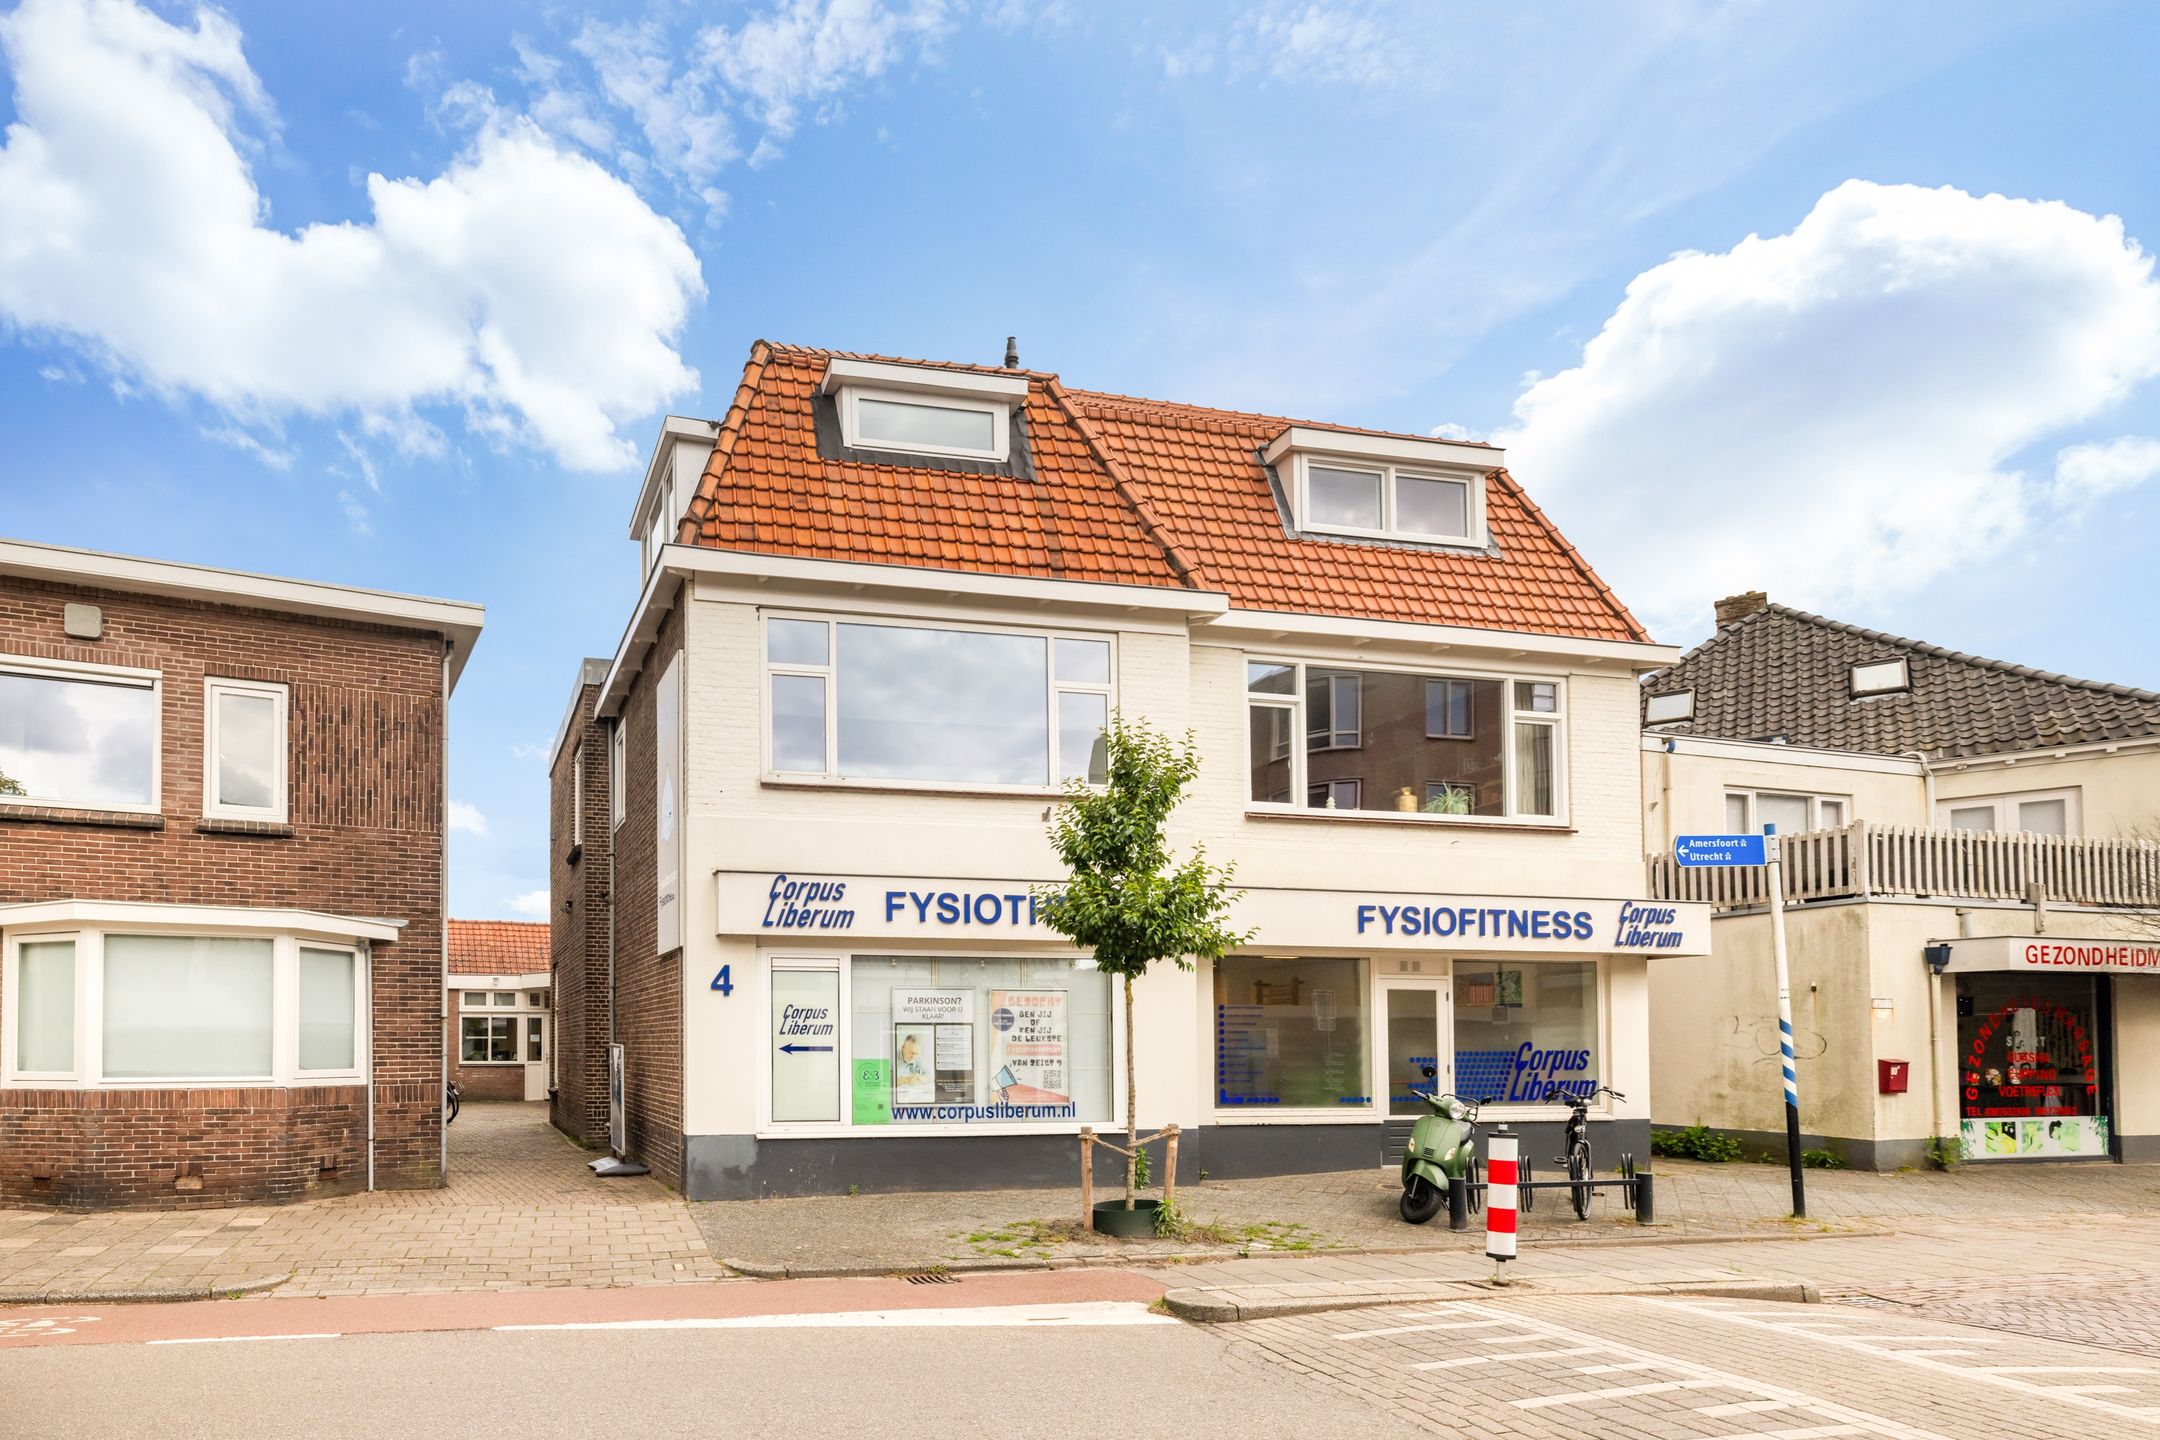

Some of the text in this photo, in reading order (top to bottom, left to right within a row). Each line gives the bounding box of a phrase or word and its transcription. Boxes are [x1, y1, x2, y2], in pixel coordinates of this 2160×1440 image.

[1689, 839, 1739, 848] Amersfoort
[1690, 852, 1723, 861] Utrecht
[769, 874, 846, 907] Corpus
[762, 902, 855, 928] Liberum
[885, 891, 1066, 926] FYSIOTH
[1619, 901, 1677, 929] Corpus
[1357, 905, 1594, 939] FYSIOFITNESS
[1615, 924, 1683, 947] Liberum
[710, 964, 734, 997] 4
[783, 1004, 828, 1022] Corpus
[903, 1006, 913, 1014] WIJ
[907, 997, 962, 1005] PARKINSON?
[779, 1020, 834, 1035] Liberum
[1515, 1041, 1590, 1079] Corpus
[1509, 1072, 1596, 1102] Liberum
[892, 1102, 1076, 1123] www.corpusliberum.nl
